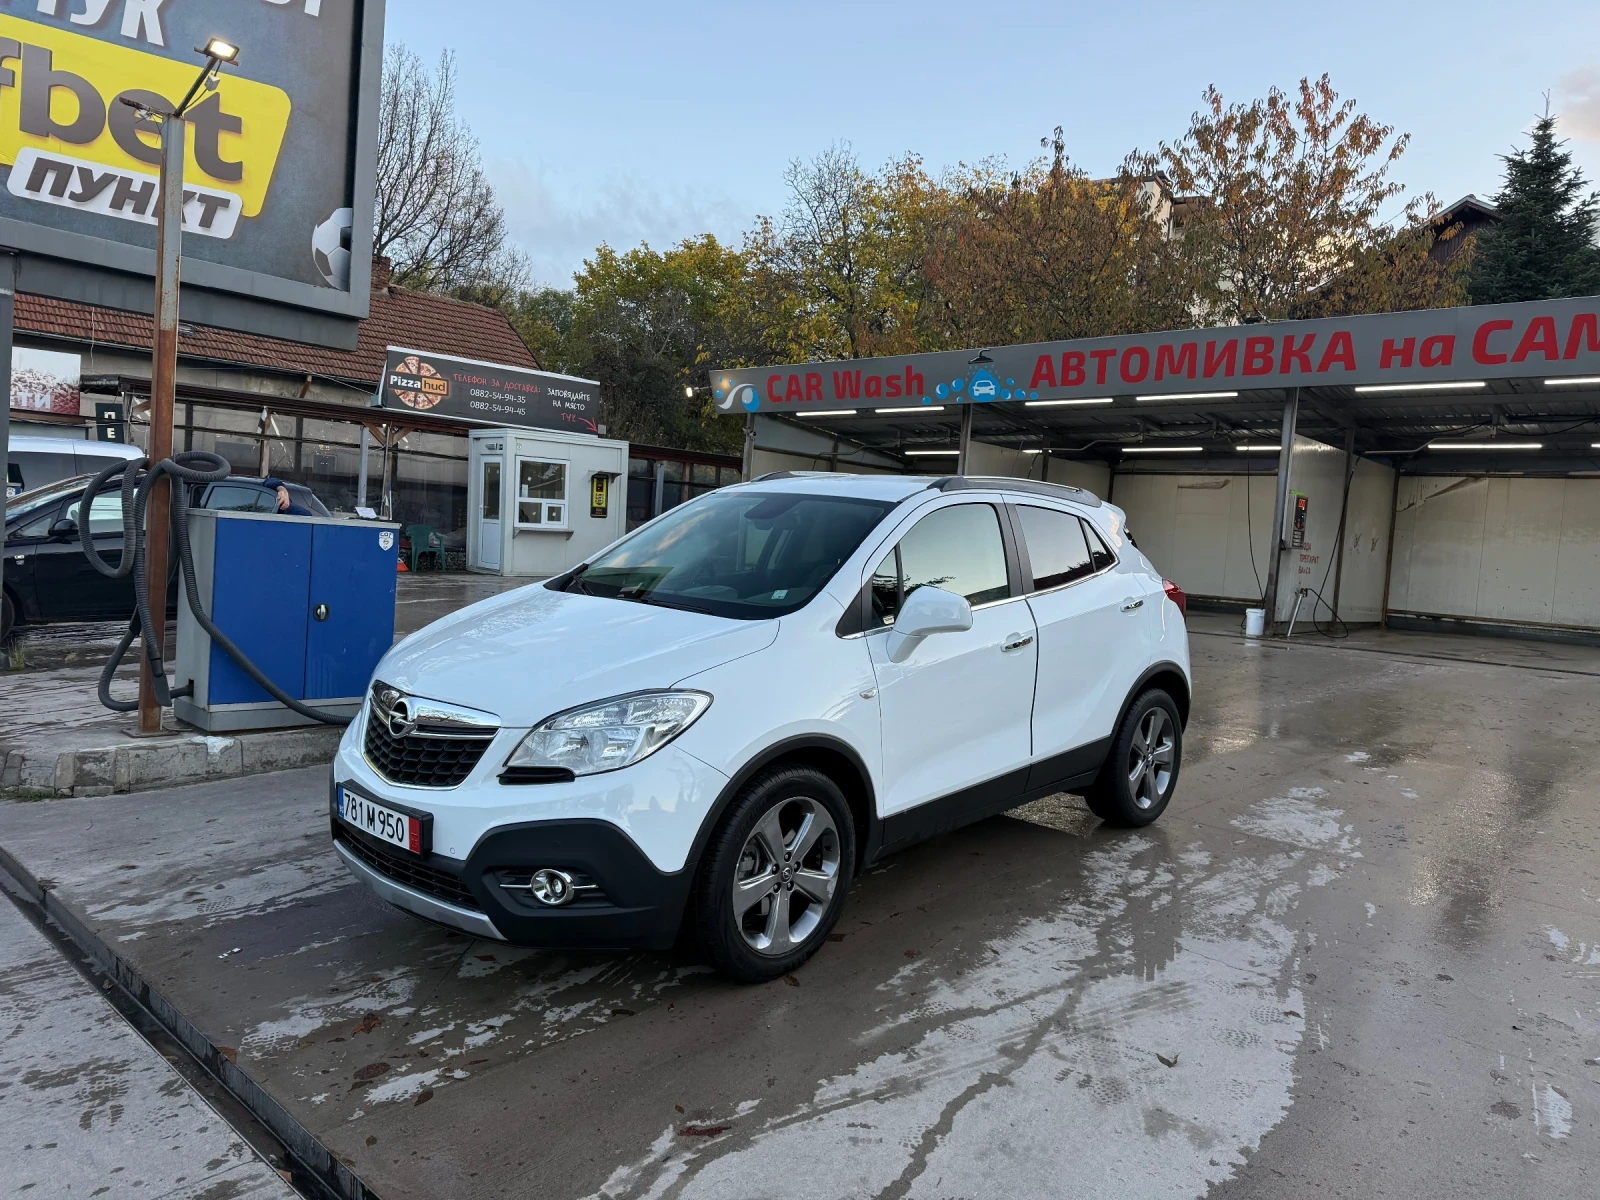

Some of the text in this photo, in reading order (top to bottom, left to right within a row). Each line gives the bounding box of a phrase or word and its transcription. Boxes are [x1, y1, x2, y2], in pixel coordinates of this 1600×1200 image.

[1029, 331, 1357, 389] АВТОМИВКА
[1379, 334, 1456, 369] на
[390, 375, 445, 391] Pizza hud
[453, 373, 487, 385] ТЕЛЕФОН
[492, 379, 500, 387] ЗА
[766, 365, 924, 403] CAR Wash
[470, 389, 526, 404] 0882-54-94-35
[547, 387, 591, 401] ЗАПОВЯДАЙТЕ
[470, 400, 526, 415] 0882-54-94-45
[552, 400, 585, 411] НА МЯСТО
[561, 413, 576, 423] ТУК
